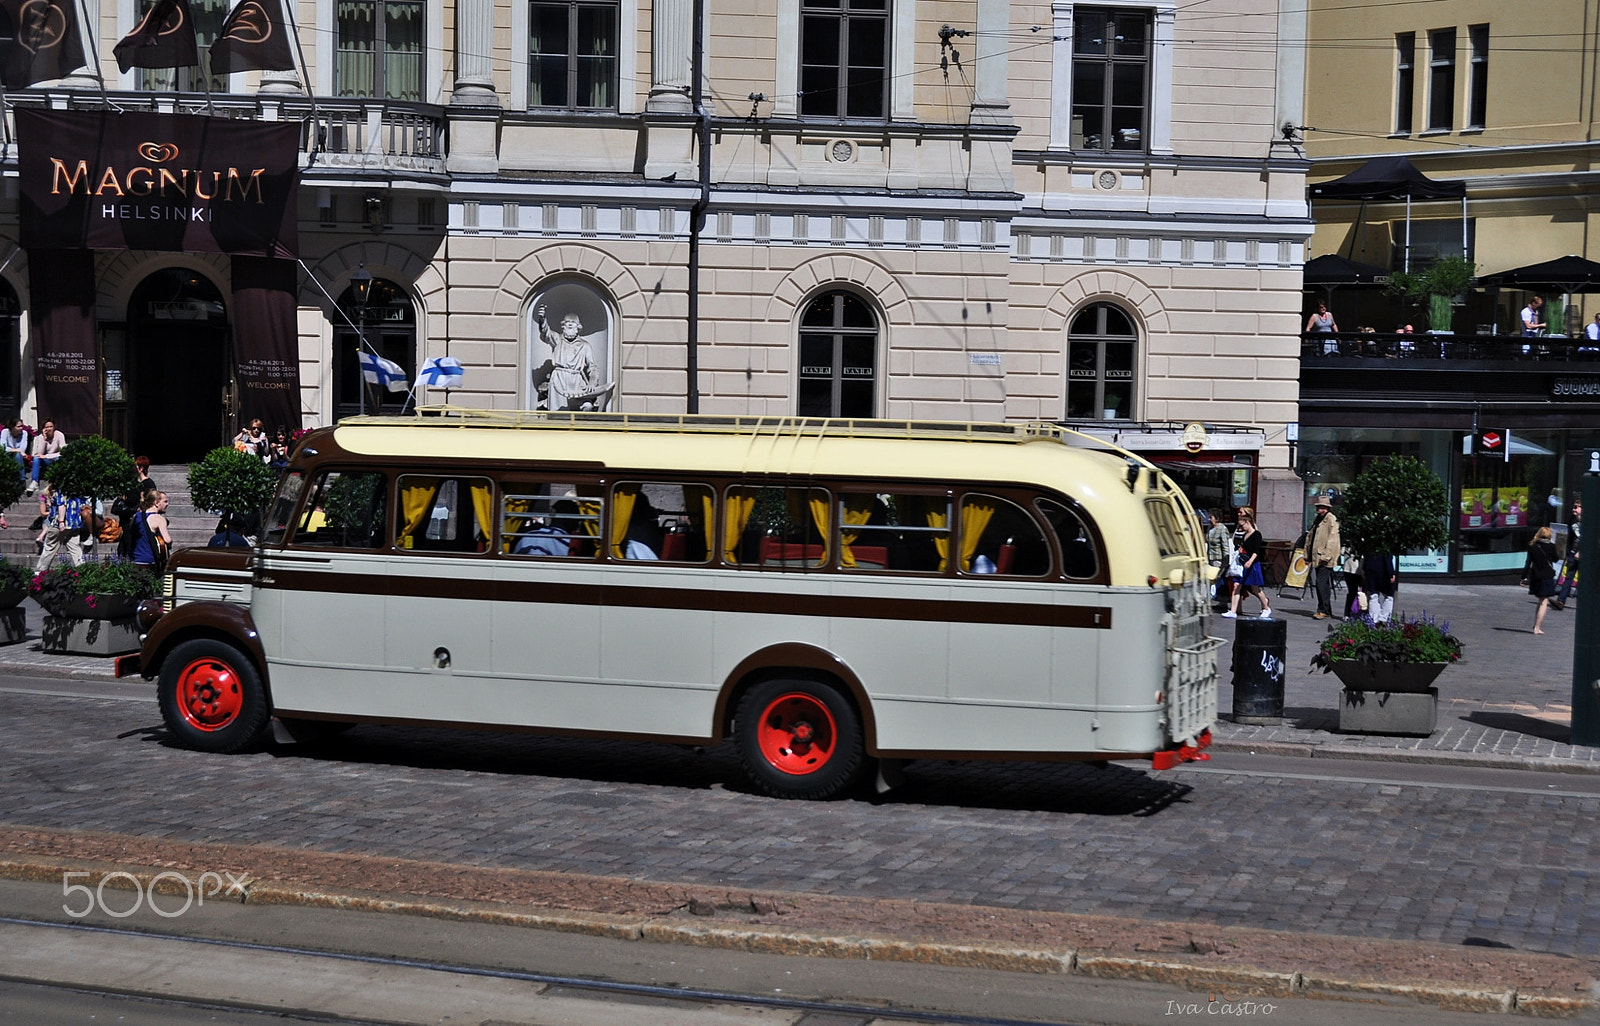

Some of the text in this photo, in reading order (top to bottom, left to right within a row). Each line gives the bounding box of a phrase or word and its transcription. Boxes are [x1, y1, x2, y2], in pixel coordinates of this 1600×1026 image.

[50, 157, 265, 204] MAGNUM
[102, 204, 212, 222] HELSINKI
[46, 375, 89, 383] WELCOME!
[247, 381, 290, 389] WELCOME!
